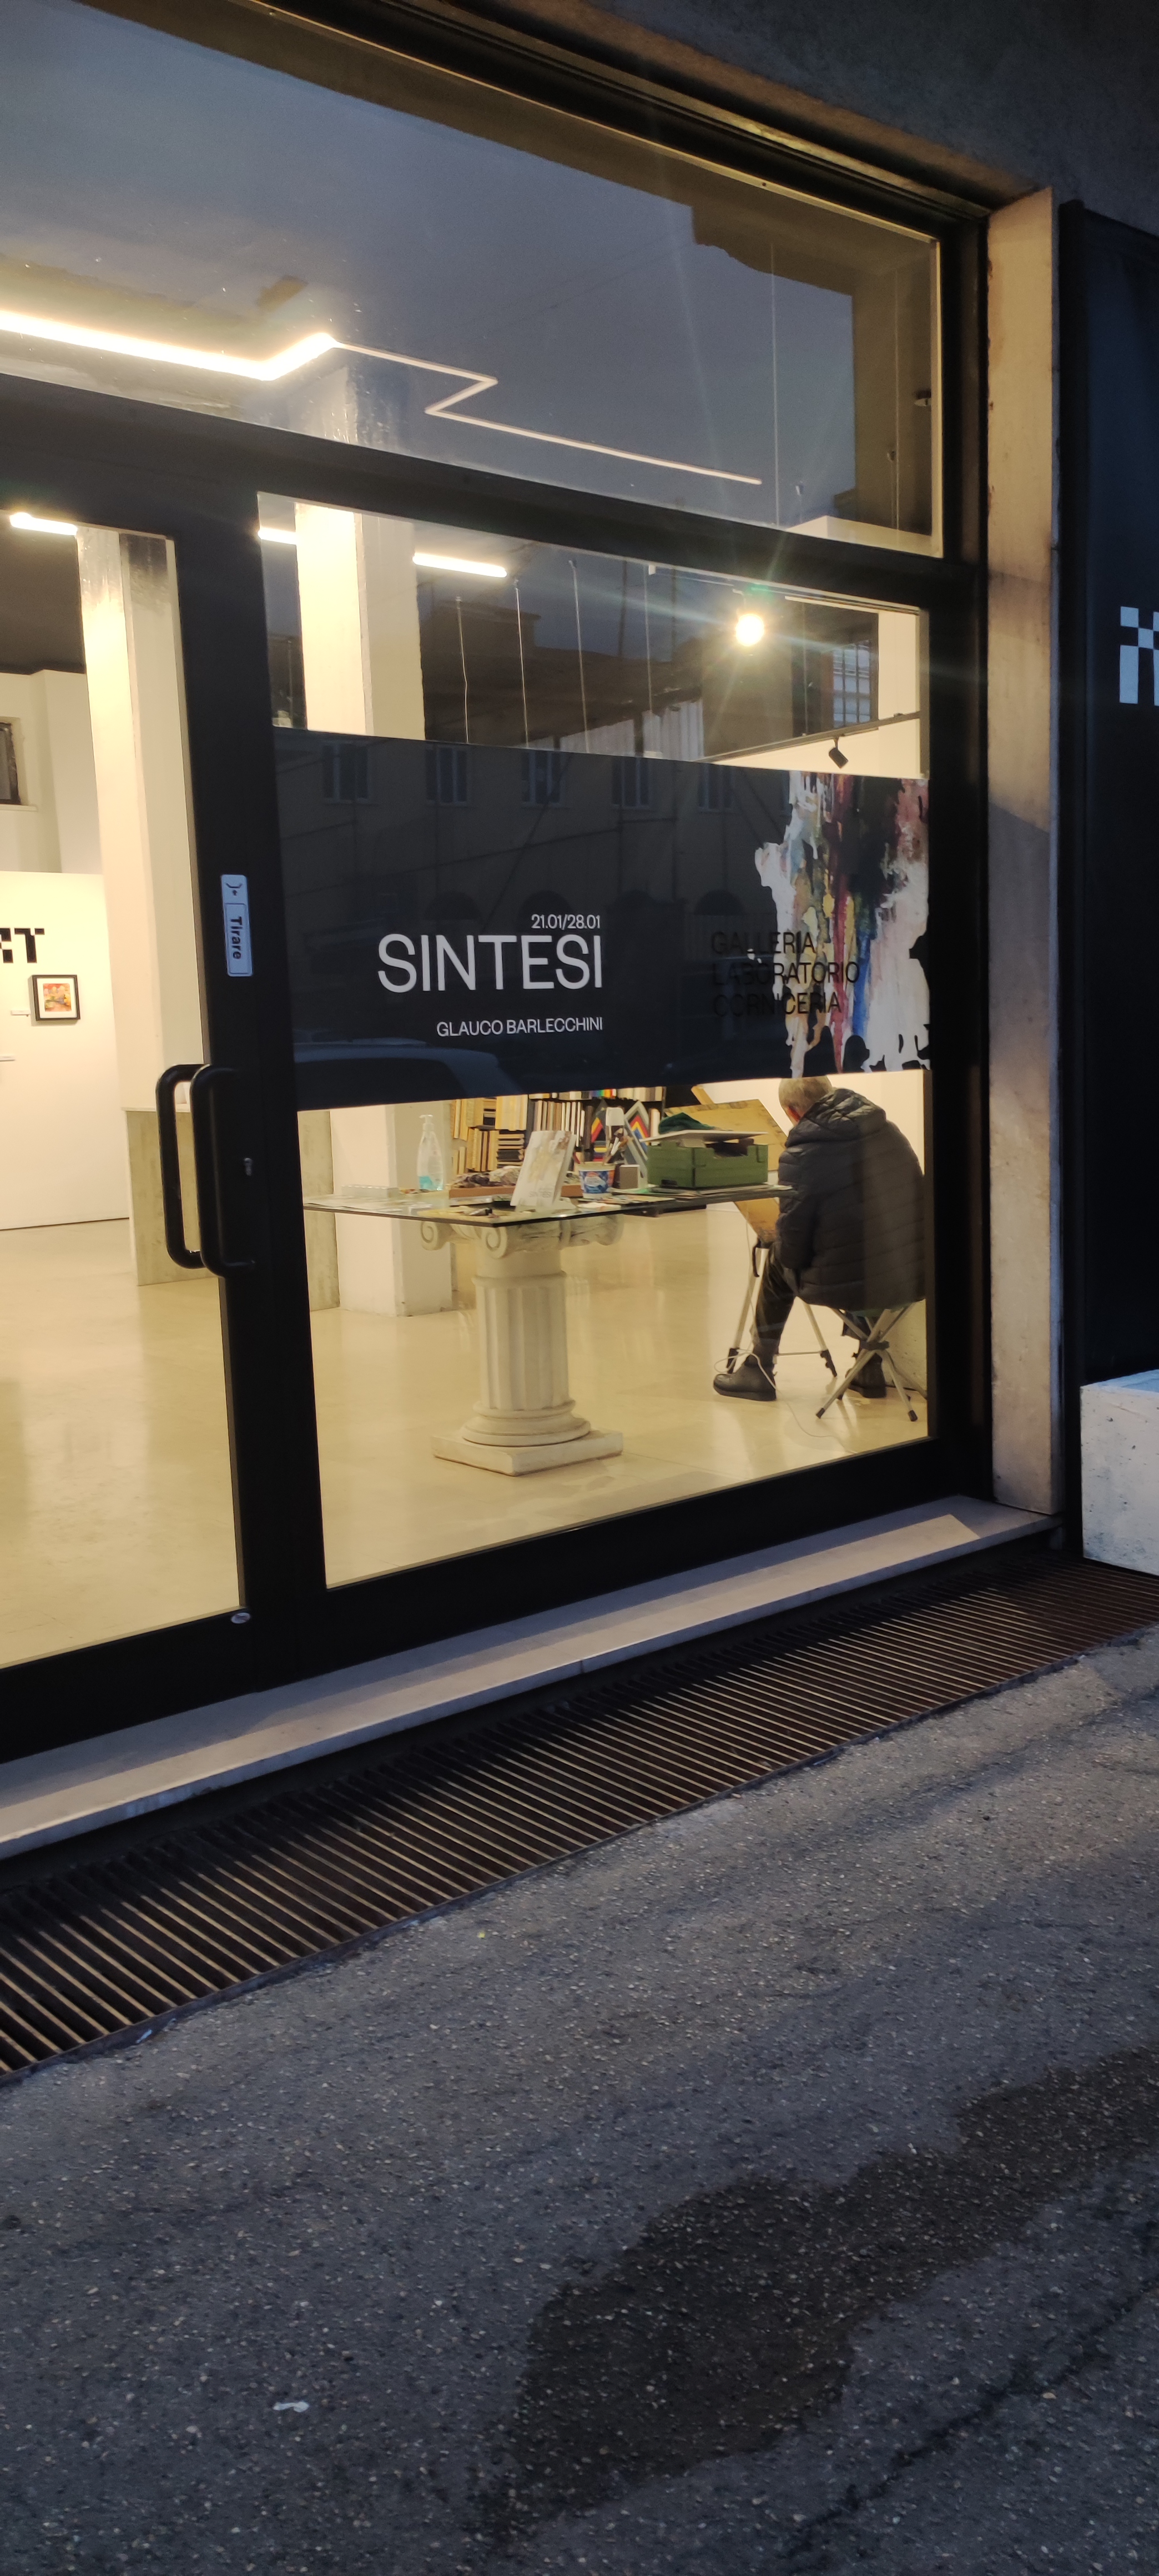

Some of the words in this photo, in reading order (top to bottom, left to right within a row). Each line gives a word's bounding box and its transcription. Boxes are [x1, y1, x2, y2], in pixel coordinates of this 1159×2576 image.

[531, 914, 601, 930] 21.01/28.01
[230, 916, 243, 960] Tirare
[711, 931, 817, 955] GALLERIA
[377, 933, 602, 993] SINTESI
[712, 961, 860, 985] LABORATORIO
[436, 1020, 503, 1037] GLAUCO
[506, 1017, 603, 1034] BARLECCHINI
